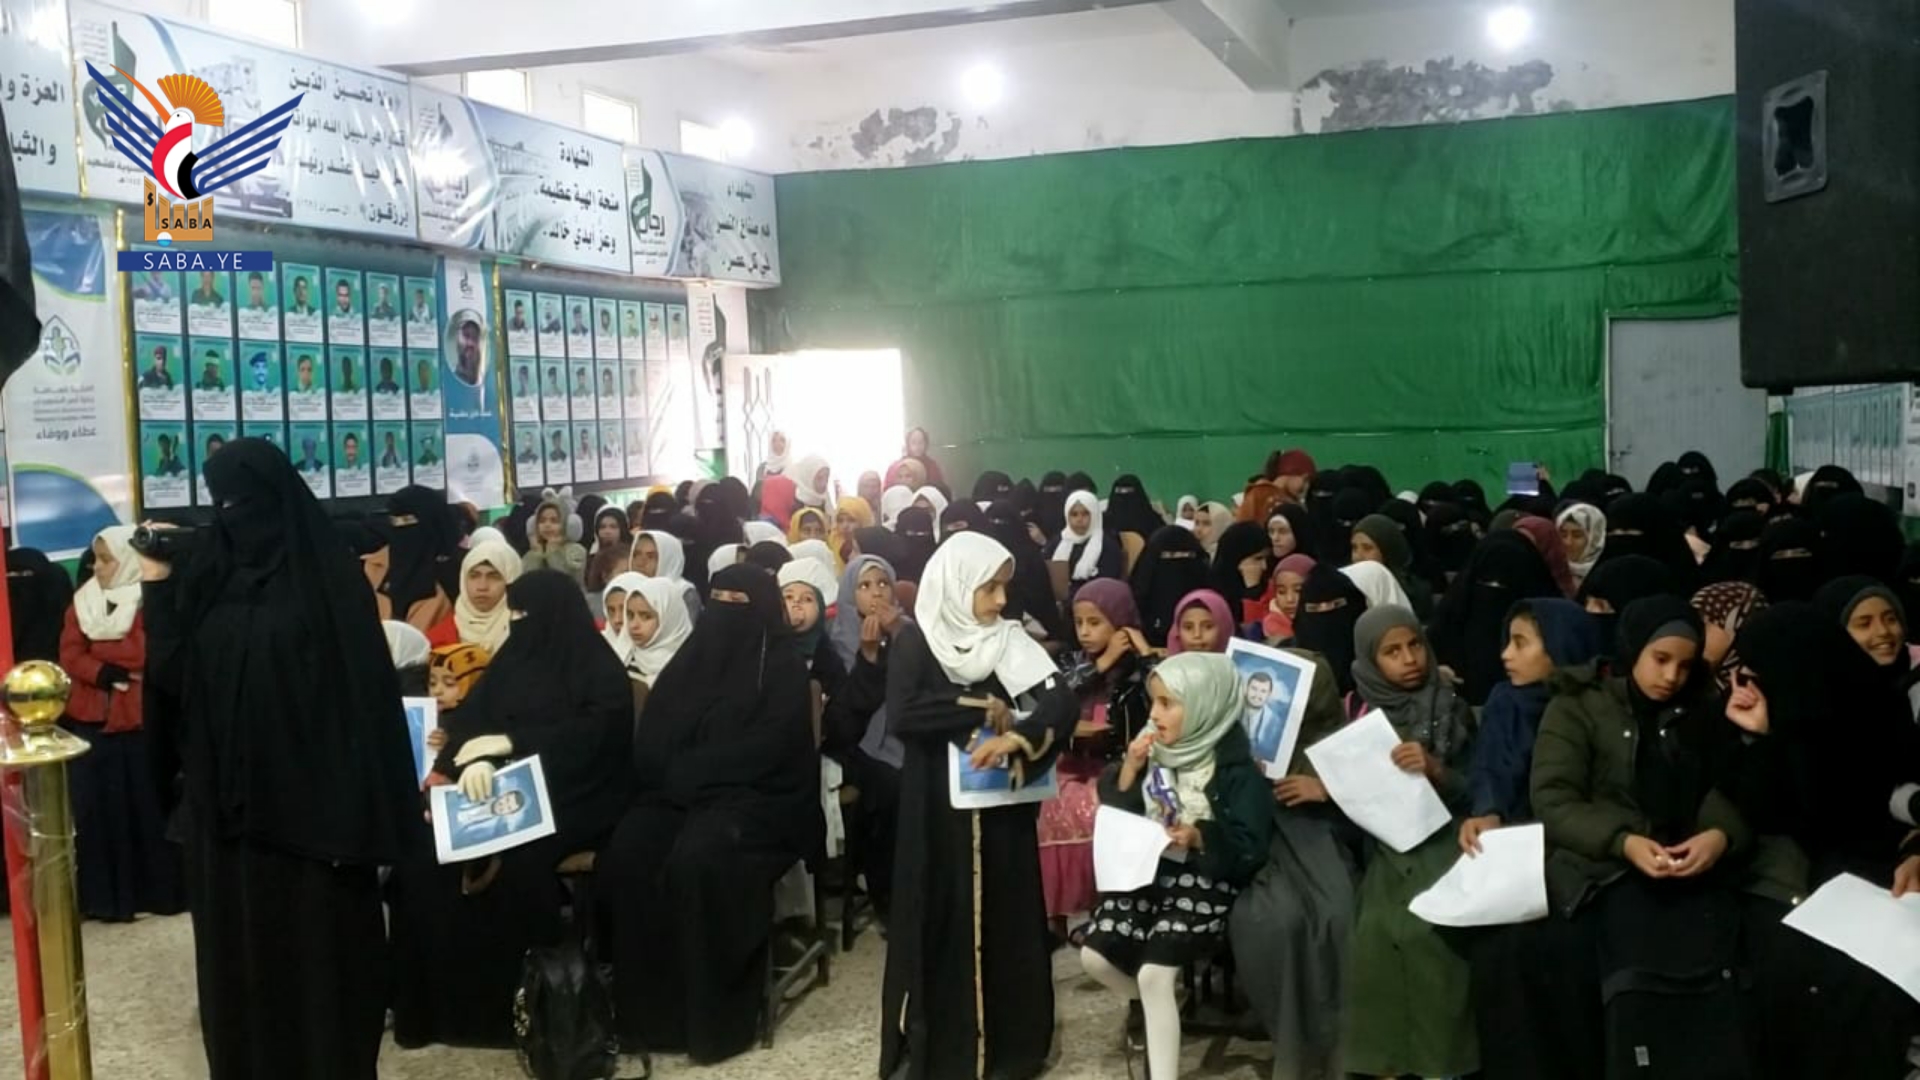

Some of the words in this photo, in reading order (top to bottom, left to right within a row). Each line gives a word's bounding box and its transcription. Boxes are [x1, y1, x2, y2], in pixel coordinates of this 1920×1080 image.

[20, 73, 64, 106] العزة
[10, 130, 57, 165] والثبا
[559, 141, 594, 169] الشهادة
